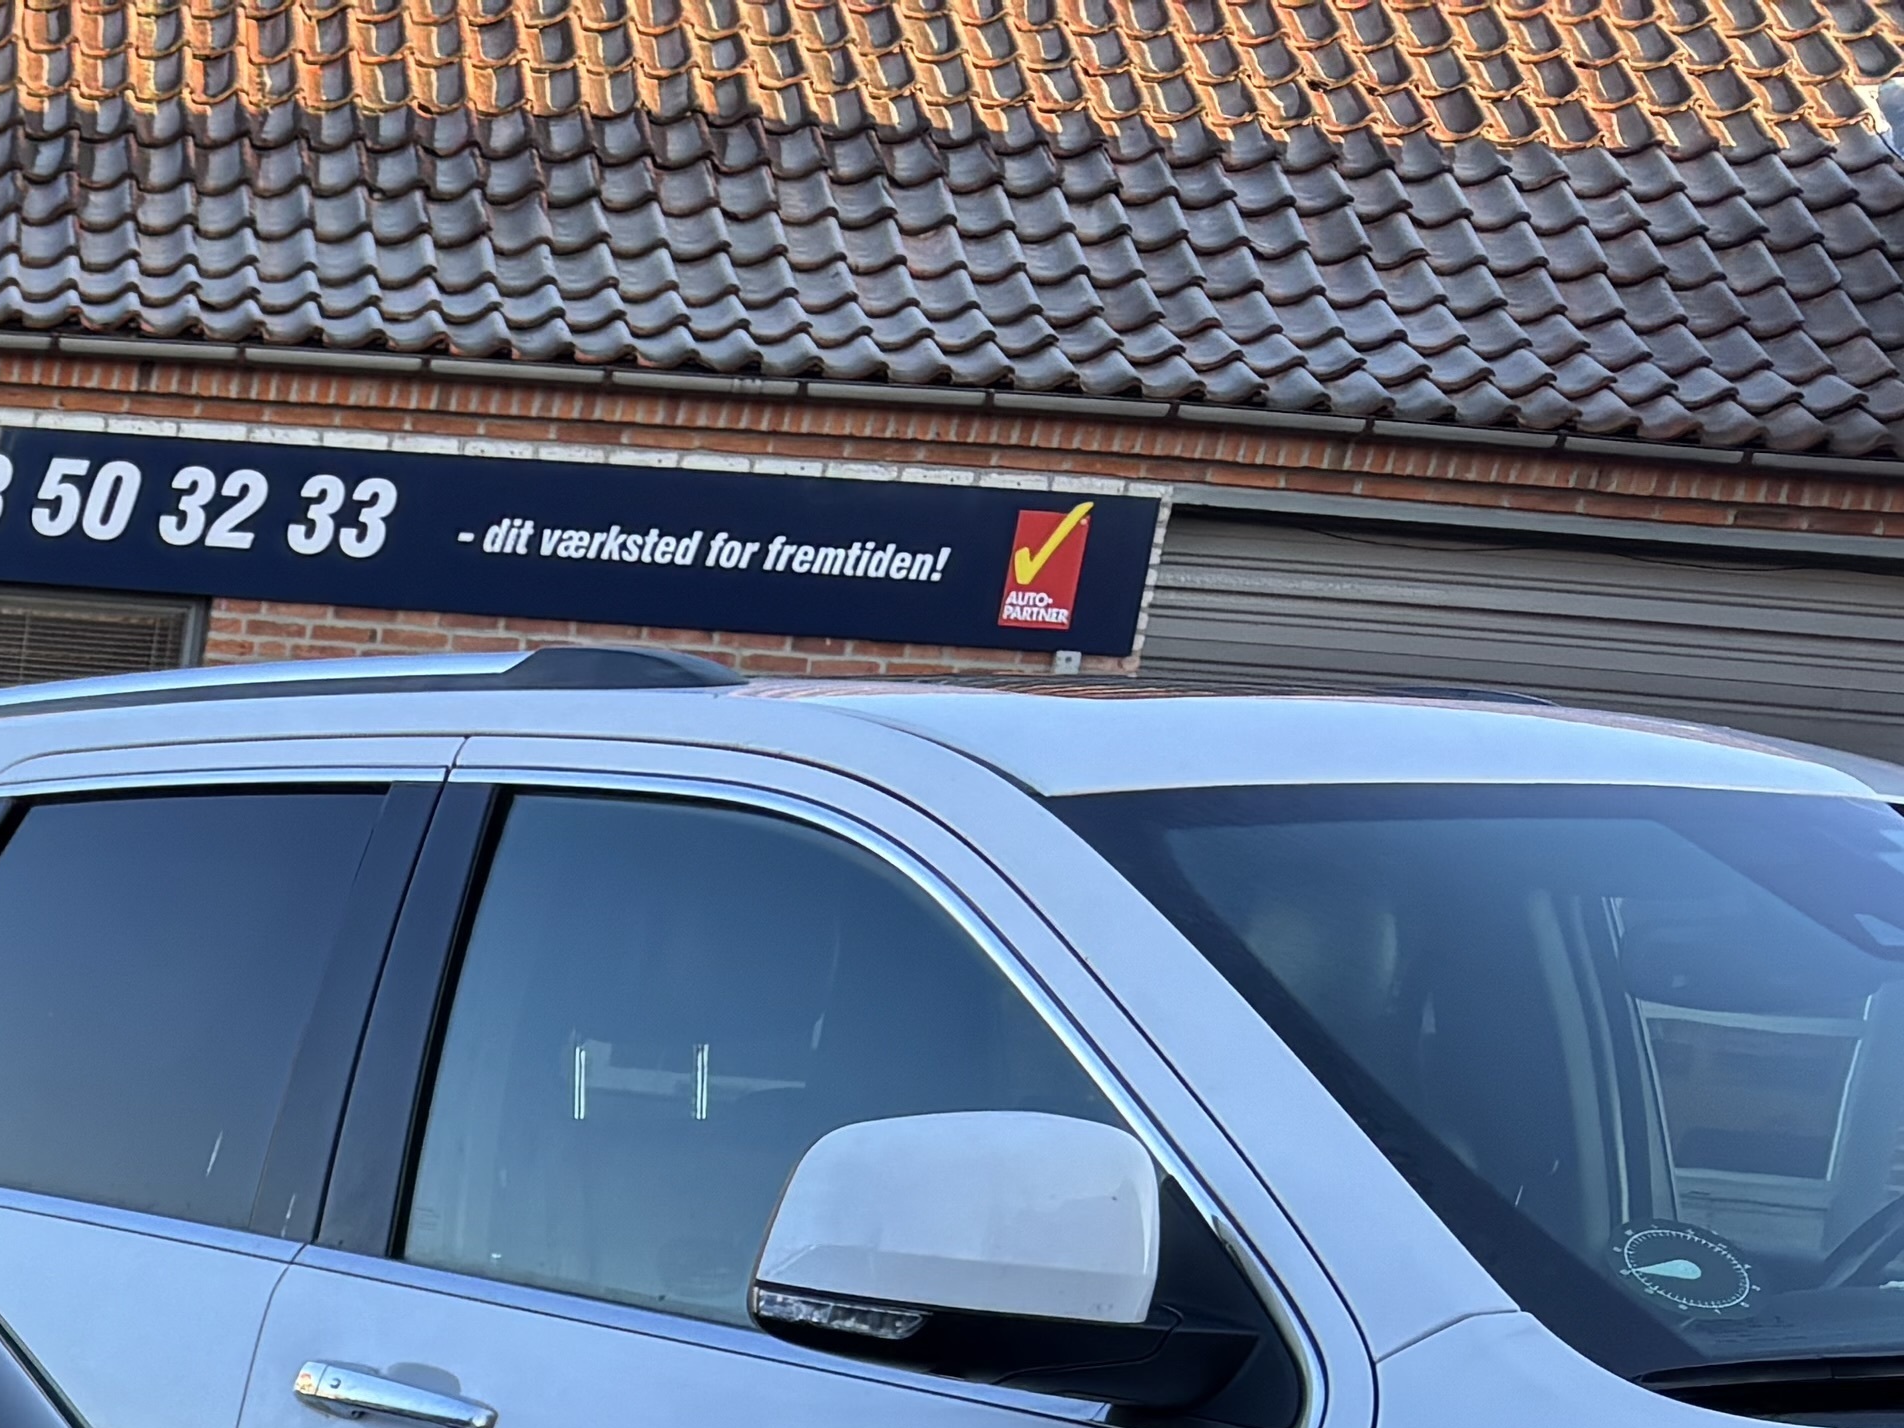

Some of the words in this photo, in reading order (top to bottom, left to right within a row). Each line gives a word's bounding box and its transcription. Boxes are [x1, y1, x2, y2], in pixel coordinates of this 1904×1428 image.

[31, 457, 142, 541] 50
[158, 465, 268, 549] 32
[287, 474, 398, 558] 33
[482, 517, 535, 555] dit
[539, 524, 704, 566] værksted
[704, 531, 761, 569] for
[762, 535, 952, 582] fremtiden!
[1002, 604, 1070, 625] PARTNER
[1005, 590, 1053, 607] AUTO-
